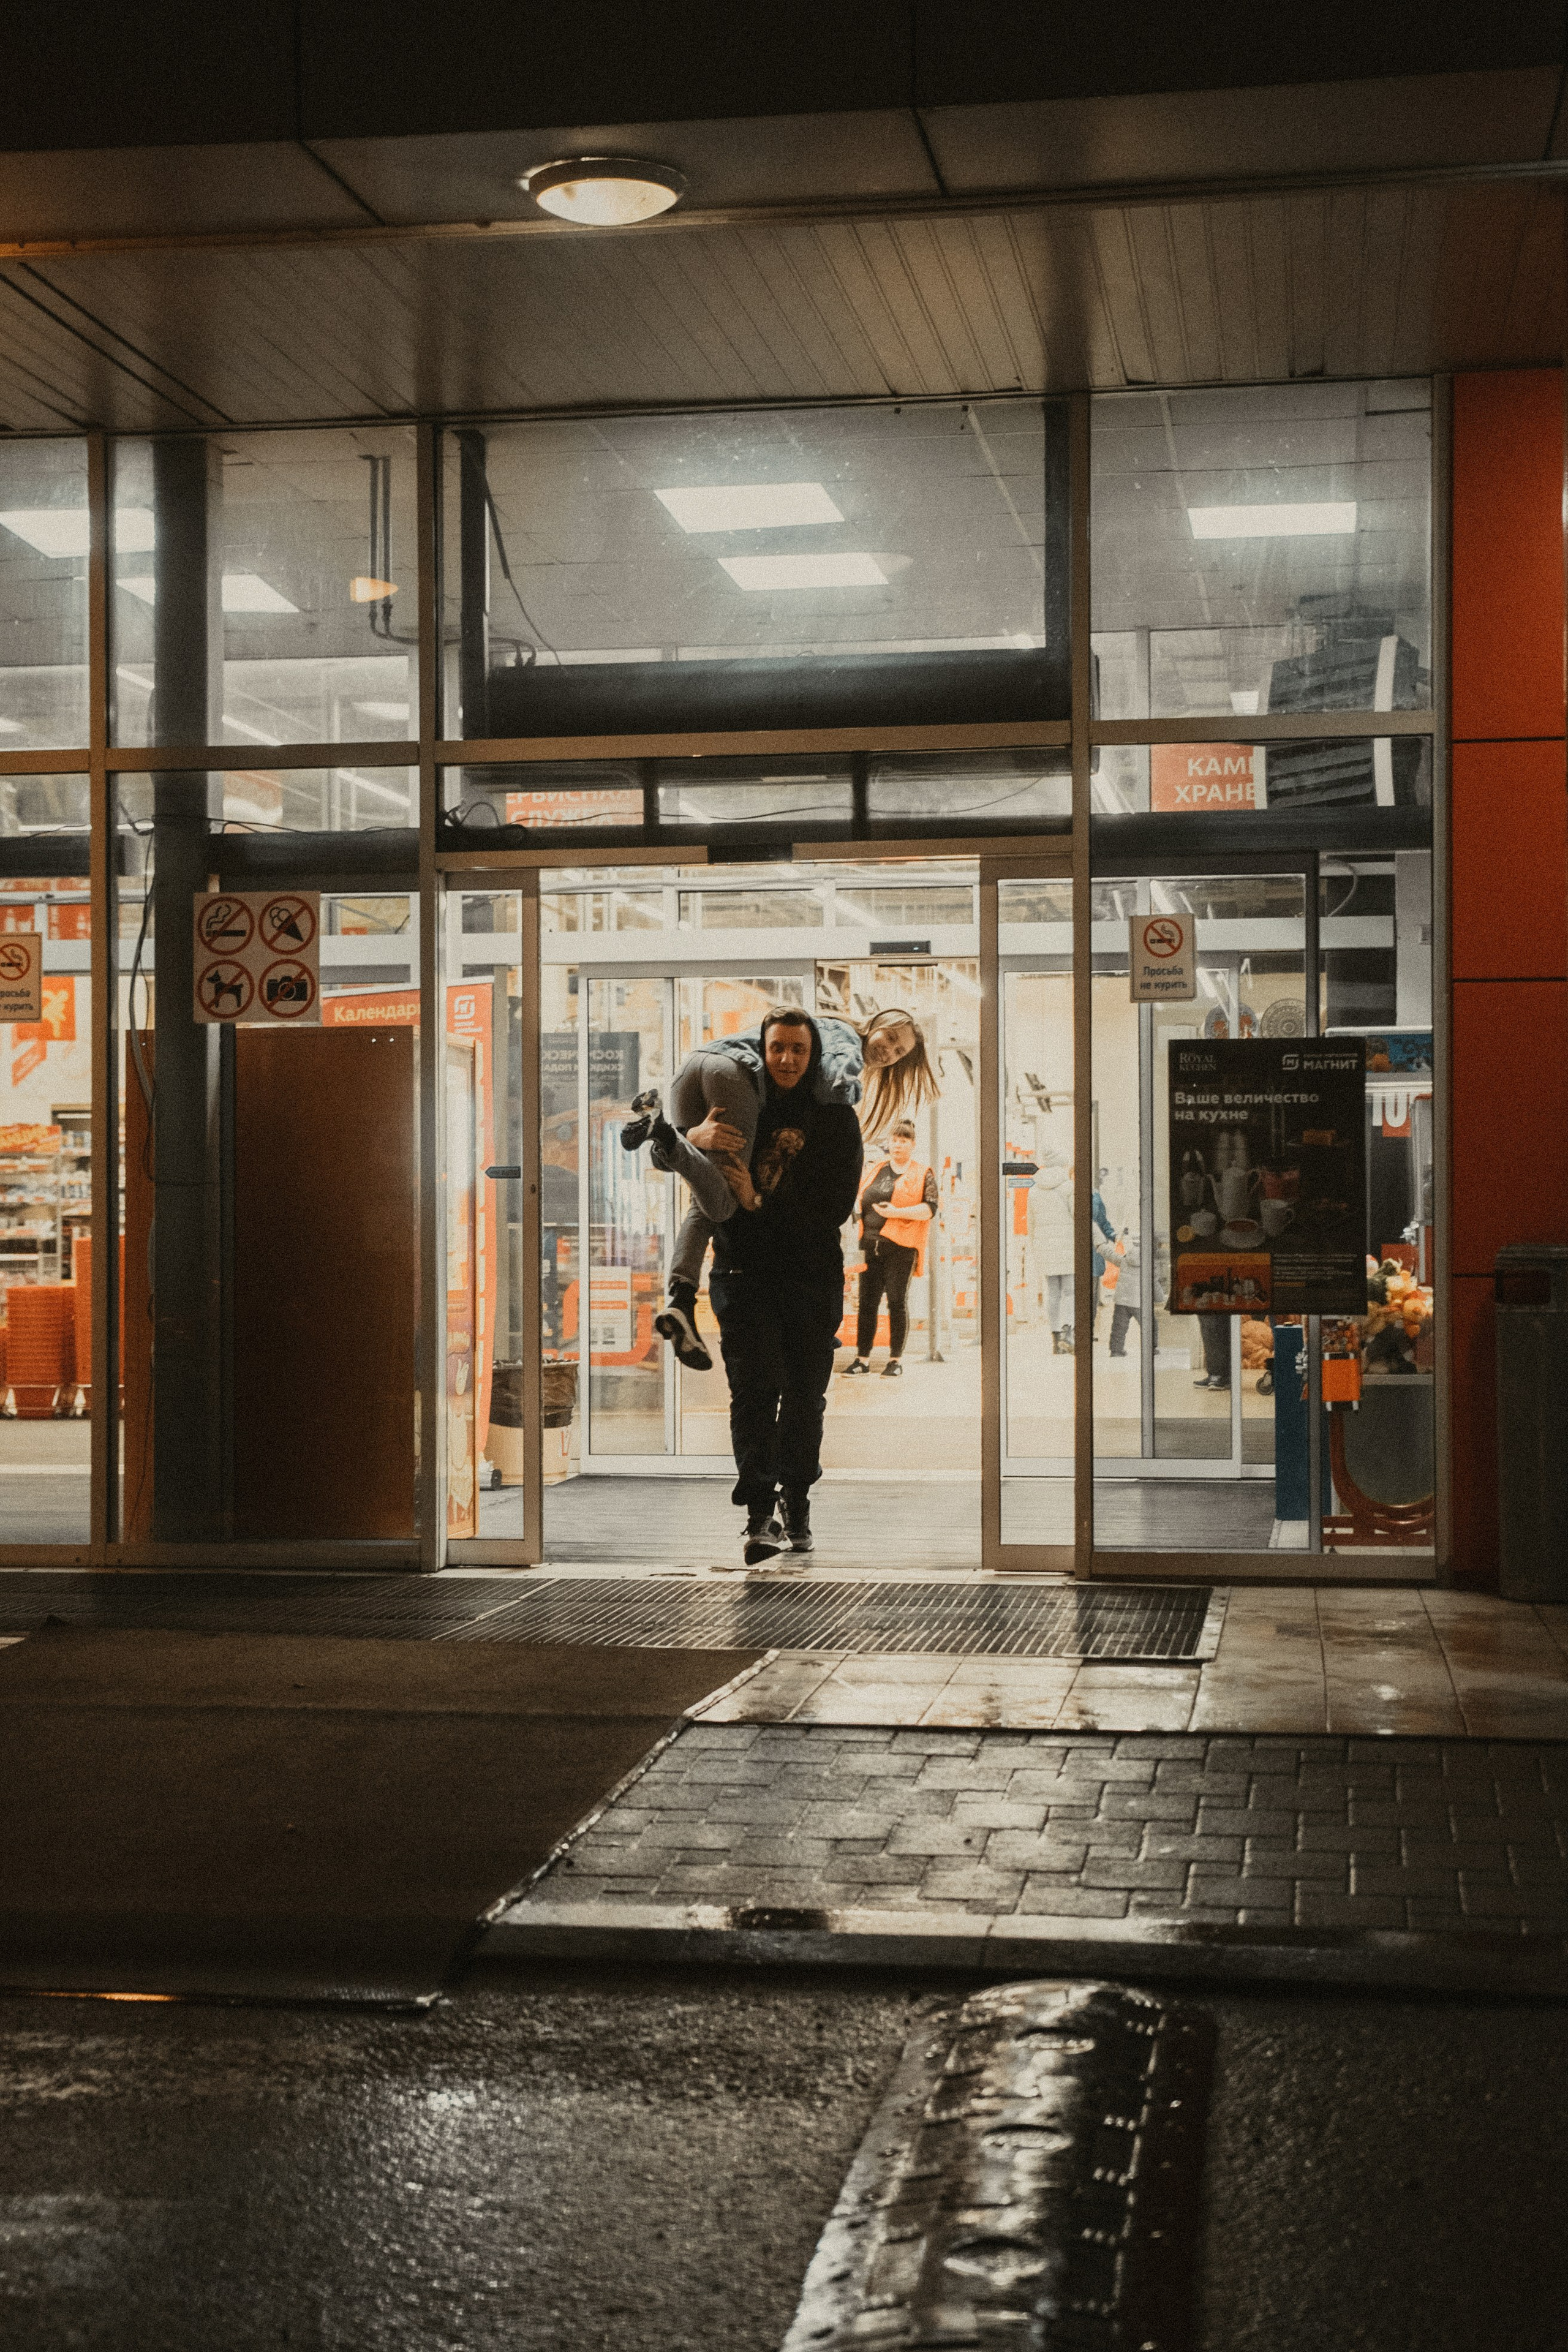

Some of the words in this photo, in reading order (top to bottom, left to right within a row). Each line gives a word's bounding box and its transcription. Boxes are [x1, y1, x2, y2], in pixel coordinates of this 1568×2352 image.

[1143, 965, 1183, 978] Просьба
[1155, 981, 1187, 991] курить
[1303, 1060, 1359, 1070] МАГНИТ
[1175, 1091, 1219, 1104] Ваше
[1224, 1093, 1319, 1104] величество
[1175, 1110, 1195, 1120] на
[1199, 1110, 1248, 1123] кухне
